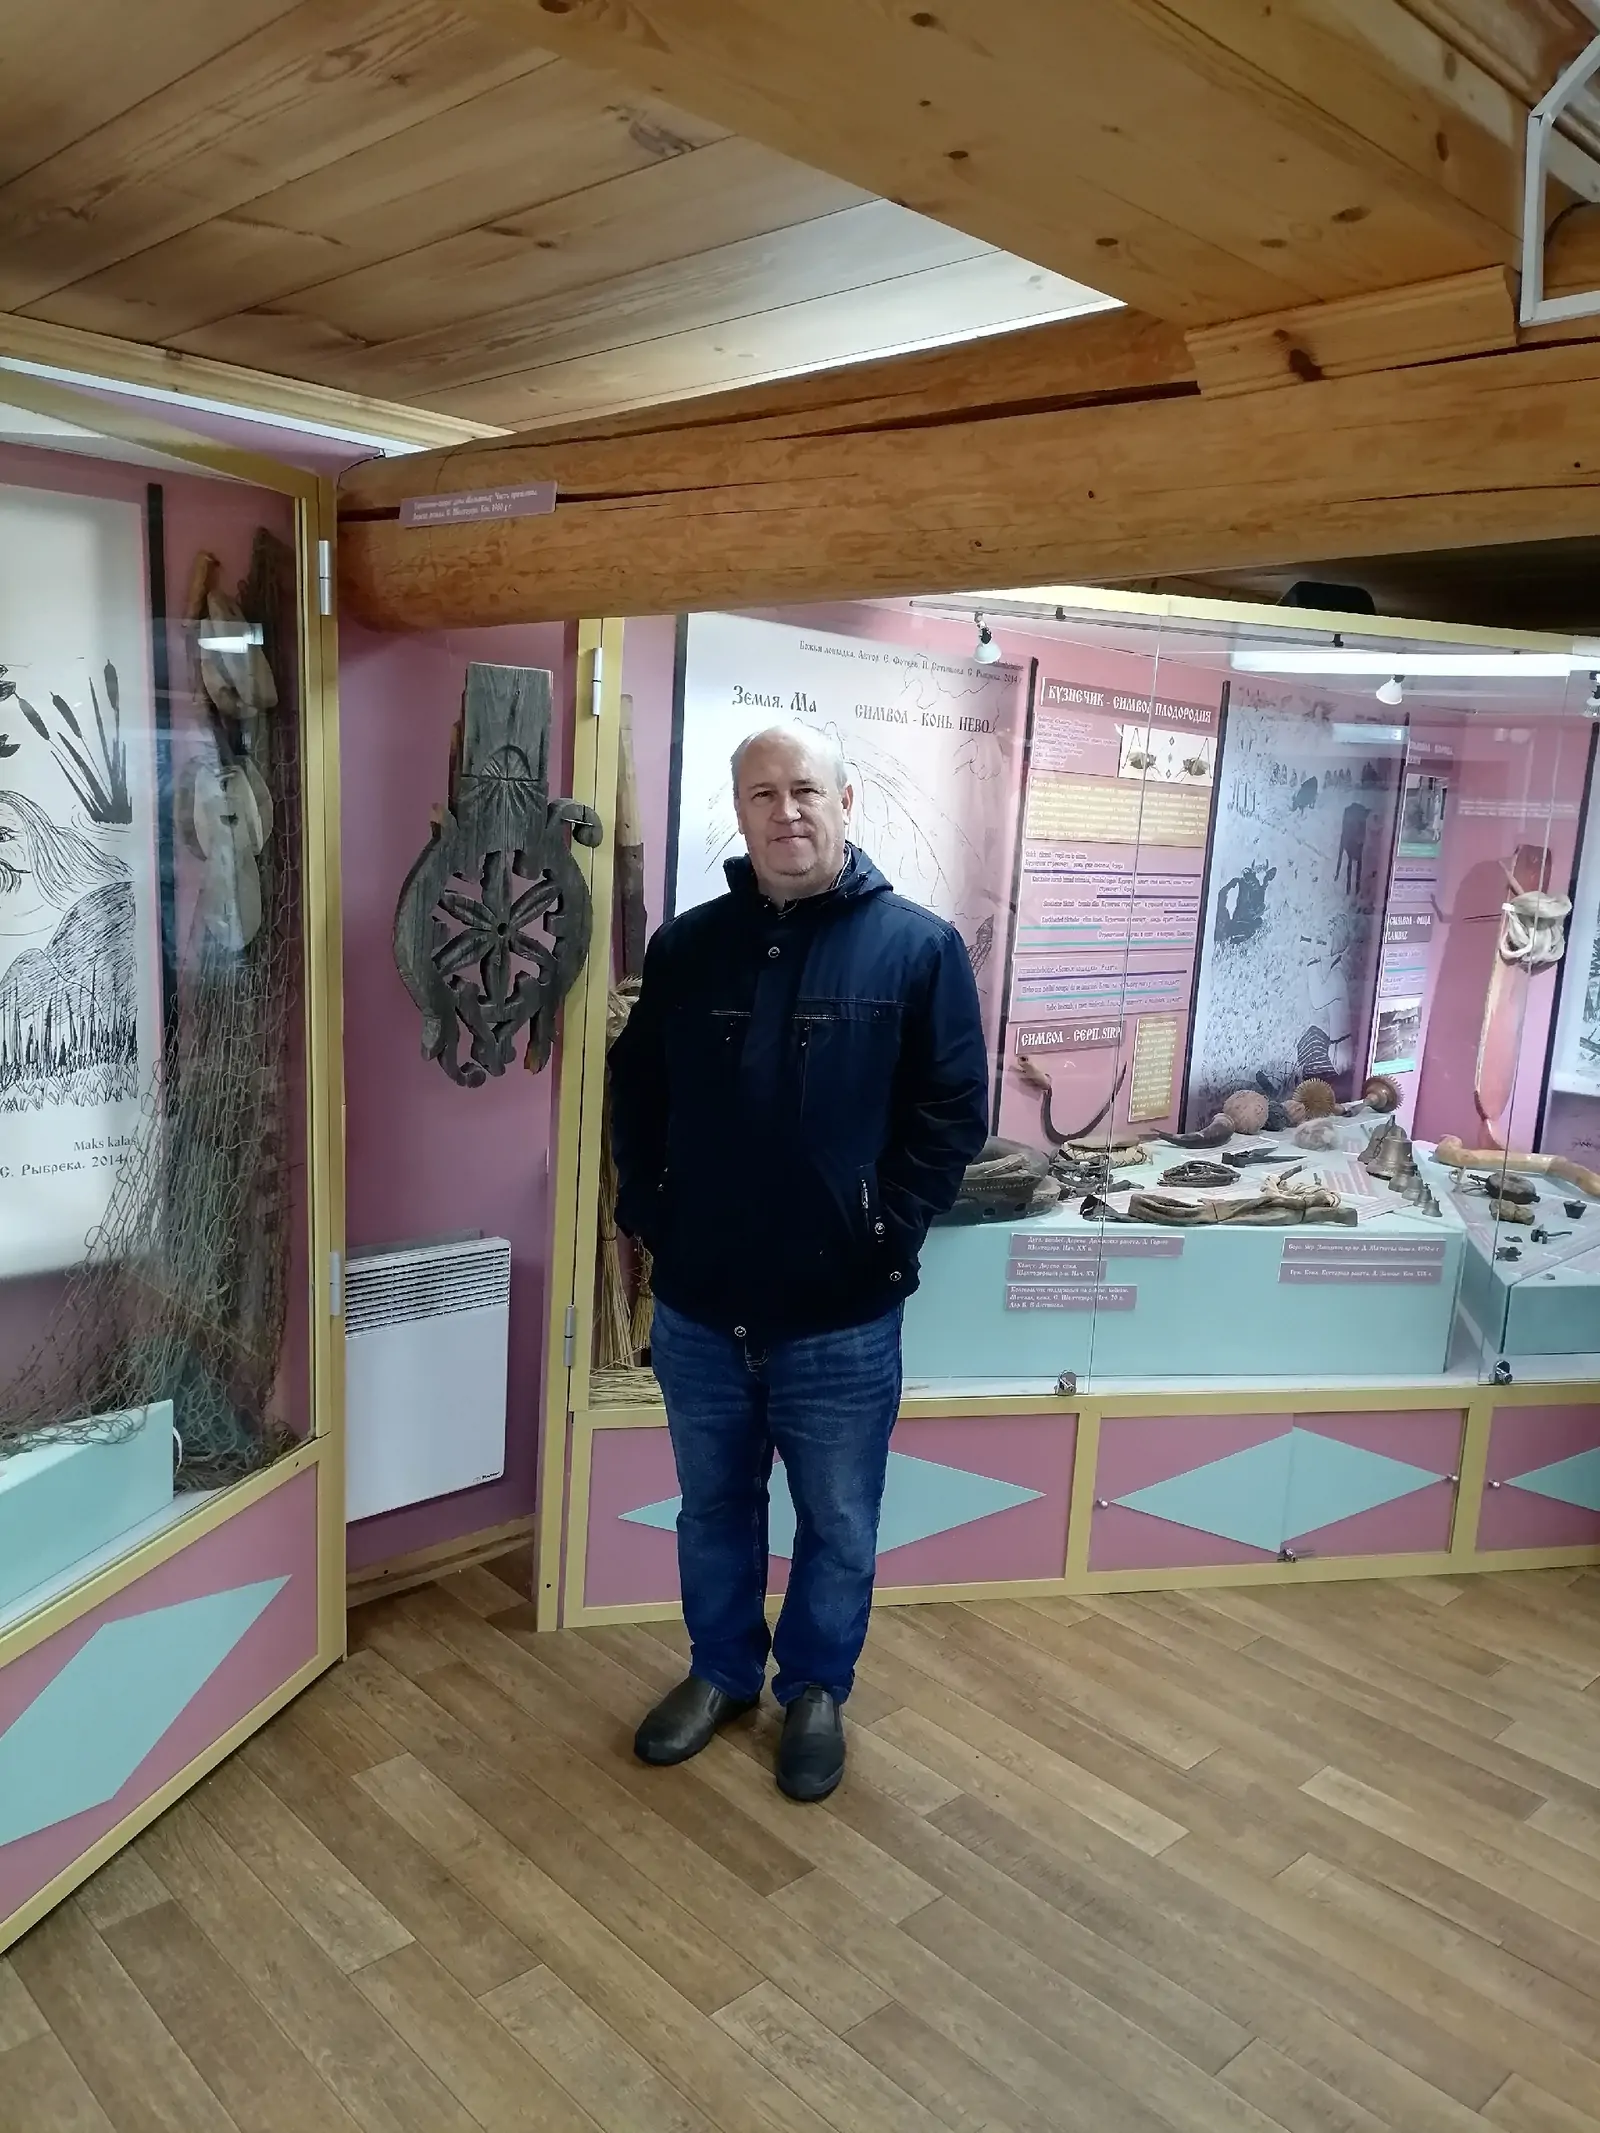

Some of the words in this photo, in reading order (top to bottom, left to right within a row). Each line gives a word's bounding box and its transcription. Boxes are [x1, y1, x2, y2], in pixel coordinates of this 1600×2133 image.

[732, 685, 784, 709] Земля.
[1048, 685, 1104, 708] КУЗНЕЧИК
[1154, 703, 1212, 723] ПЛОДОРОДИЯ
[855, 703, 908, 724] СИМВОЛ
[921, 712, 955, 730] КОНЬ.
[1021, 1031, 1063, 1046] СИМВОЛ
[74, 1138, 104, 1151] Maks
[0, 1166, 14, 1178] С.
[21, 1161, 86, 1176] Рыбрека.
[92, 1153, 124, 1168] 2014
